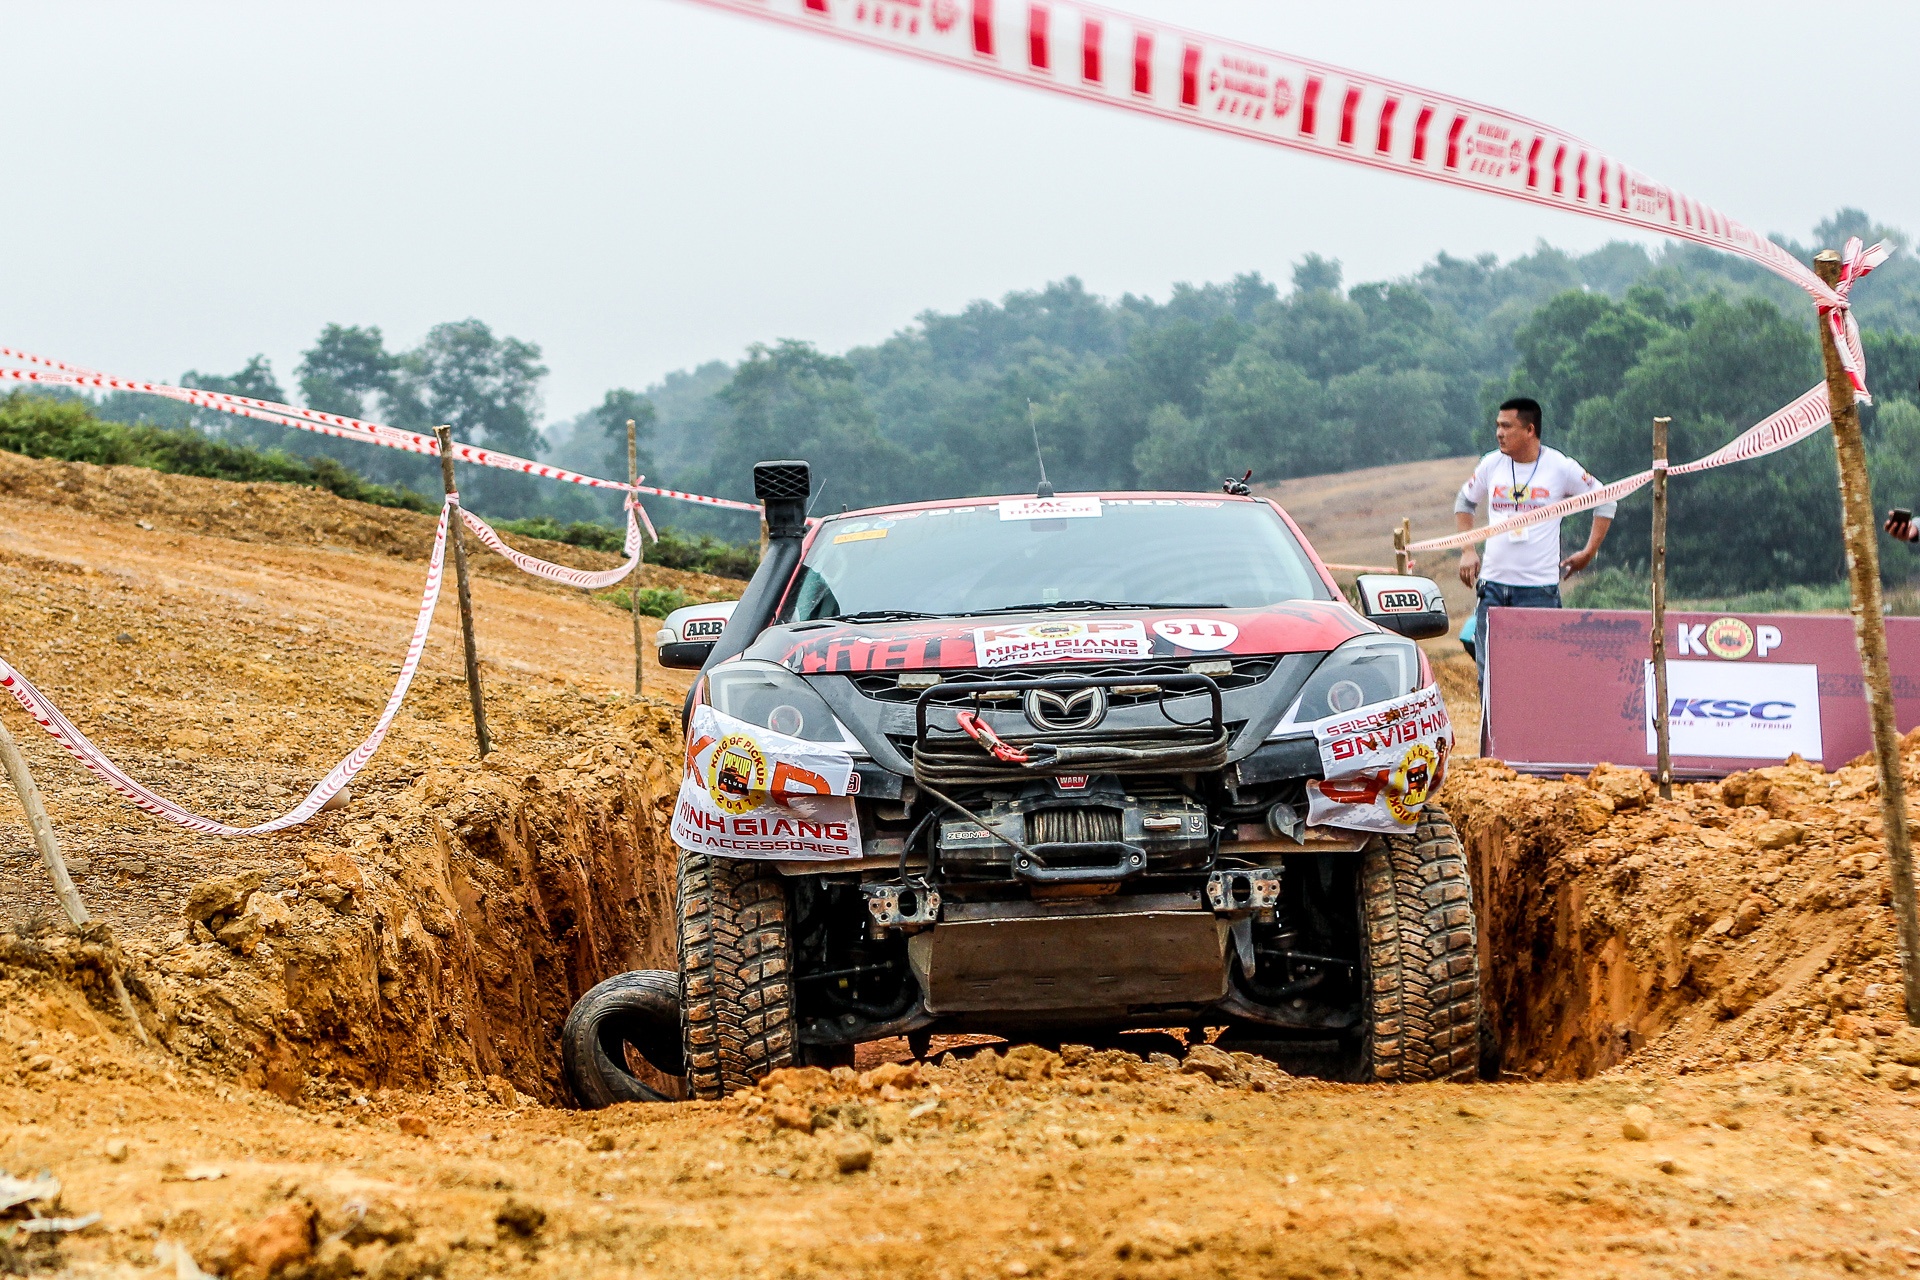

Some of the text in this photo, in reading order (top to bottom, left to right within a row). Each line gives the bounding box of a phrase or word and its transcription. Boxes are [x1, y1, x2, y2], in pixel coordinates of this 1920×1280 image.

[1384, 593, 1420, 608] ARB
[687, 622, 723, 636] ARB
[1165, 623, 1228, 637] 511
[986, 639, 1138, 657] MINH GIANG
[1669, 698, 1796, 720] KSC
[1331, 721, 1418, 761] GIANG
[711, 737, 765, 785] KING OF PICKUP
[1060, 776, 1084, 784] WARN
[717, 794, 752, 810] 2017
[680, 797, 849, 841] MINH GIANG
[676, 822, 850, 856] AUTO ACCESSORIES
